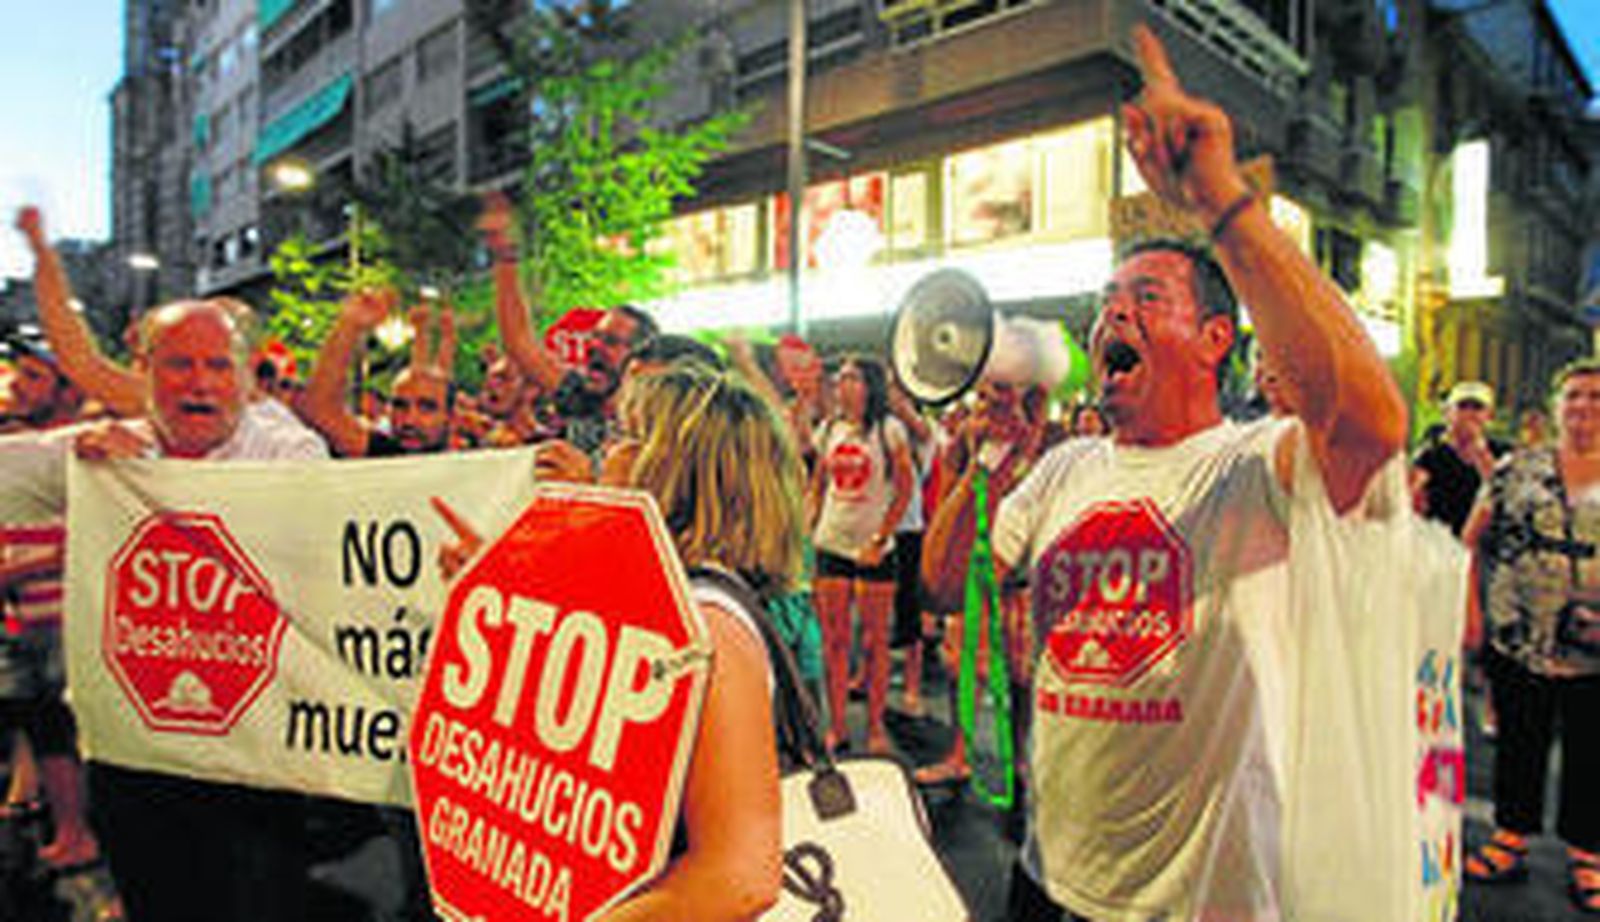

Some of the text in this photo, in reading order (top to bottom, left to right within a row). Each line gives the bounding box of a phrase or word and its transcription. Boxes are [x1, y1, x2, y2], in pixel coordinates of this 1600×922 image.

[342, 519, 421, 589] NO
[1049, 549, 1171, 602] STOP
[442, 584, 677, 772] STOP
[420, 711, 643, 873] DESAHUCIOS
[428, 797, 573, 922] GRANADA
